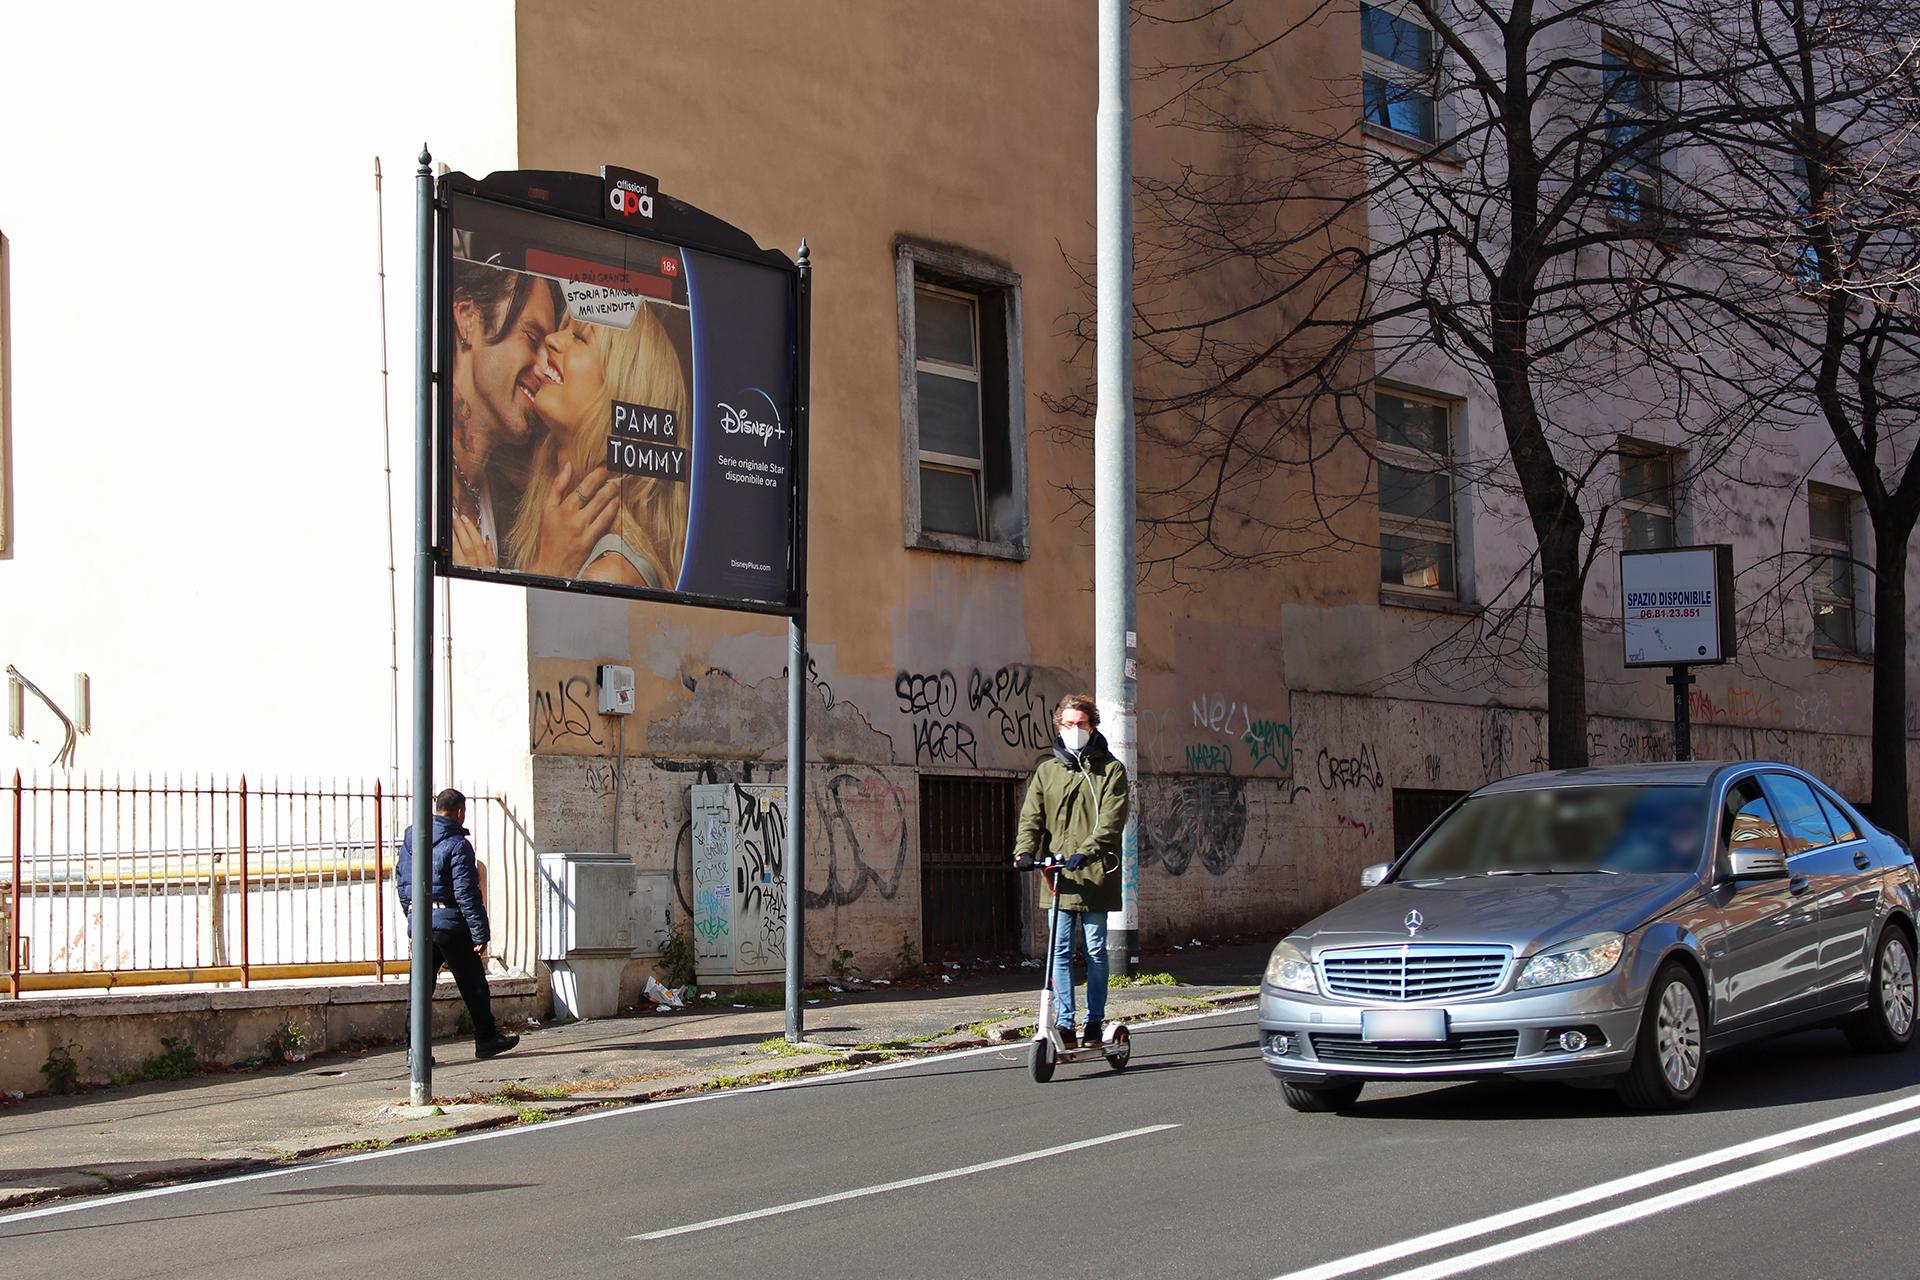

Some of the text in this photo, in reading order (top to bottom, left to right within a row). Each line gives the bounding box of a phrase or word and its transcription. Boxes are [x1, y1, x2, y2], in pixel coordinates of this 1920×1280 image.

[616, 179, 648, 195] affissioni
[609, 188, 654, 218] apa
[662, 260, 676, 272] 18+
[567, 288, 600, 302] STORIA
[578, 301, 636, 316] MAI VENDUTA
[615, 405, 674, 436] PAM &
[610, 440, 684, 474] TOMMY
[718, 454, 785, 475] Serie originale Star
[725, 470, 777, 488] disponibile ora
[731, 559, 772, 572] DisneyPlus.com
[1627, 590, 1712, 607] SPAZIO DISPONIBILE
[1640, 608, 1701, 619] 06.81.23.851
